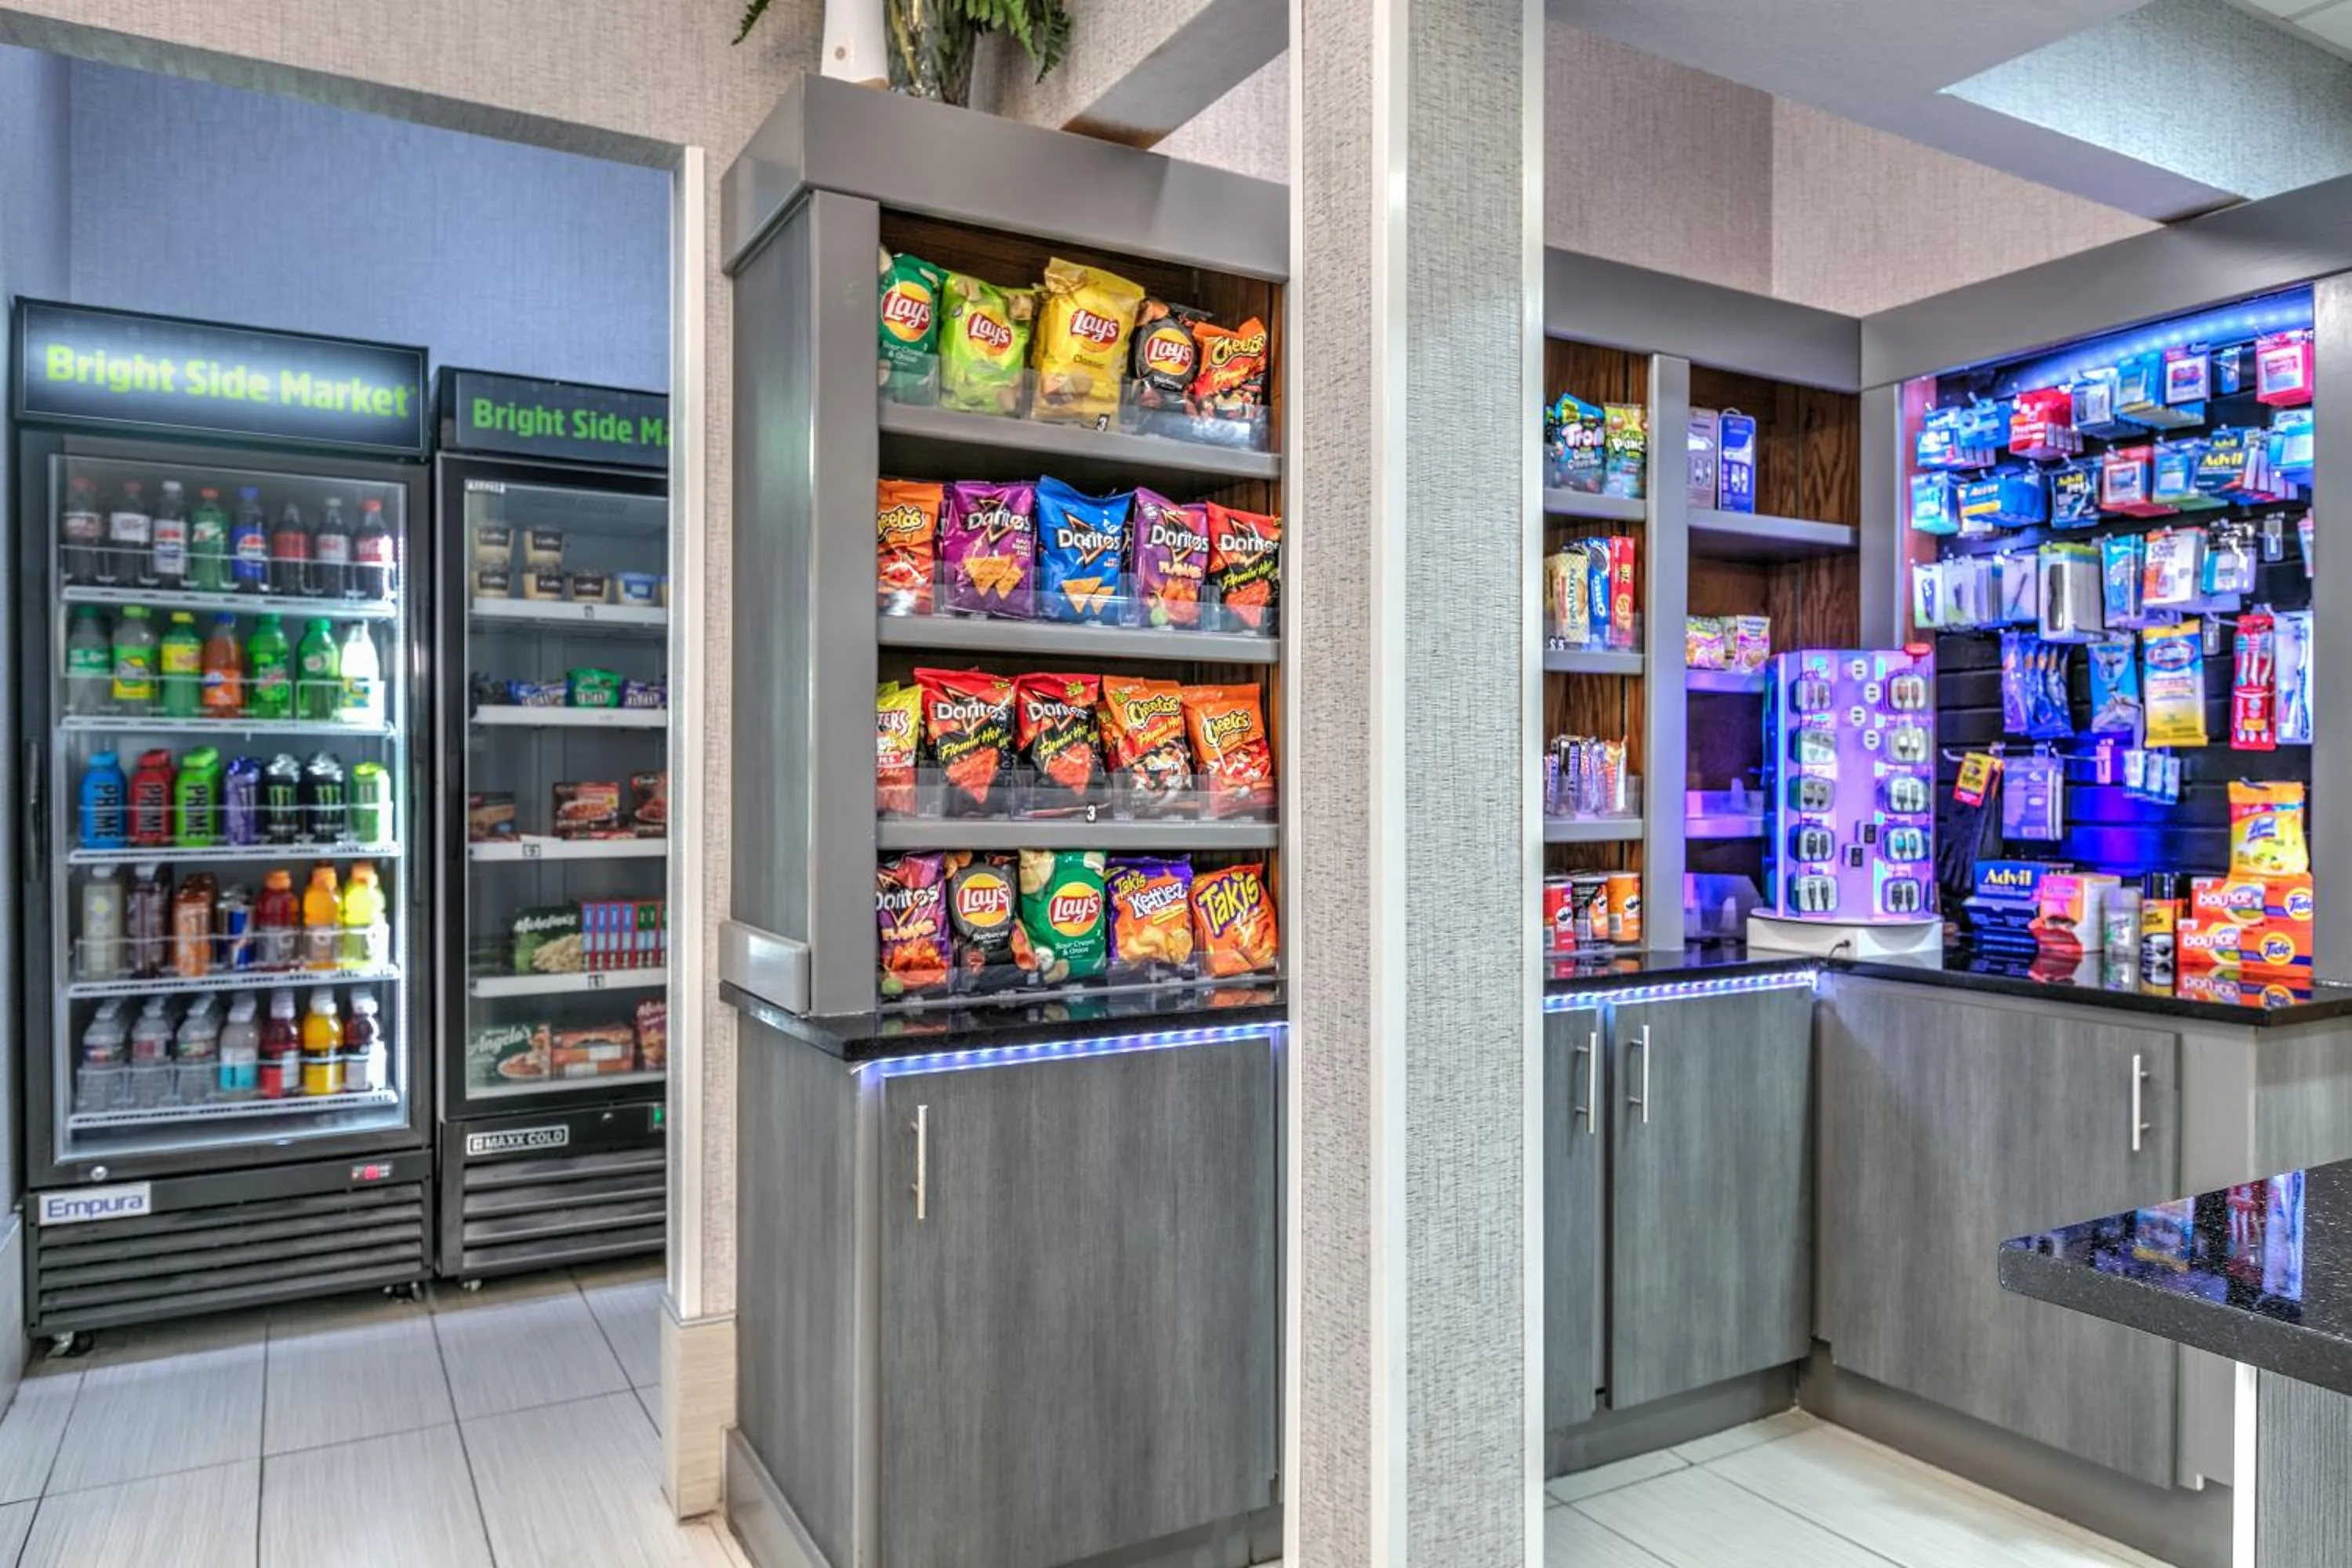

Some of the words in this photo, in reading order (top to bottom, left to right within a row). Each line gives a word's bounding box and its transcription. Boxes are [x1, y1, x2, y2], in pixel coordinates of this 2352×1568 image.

[884, 292, 931, 328] Lay's
[969, 313, 1011, 345] Lay's
[1072, 310, 1119, 343] Lay's
[1149, 337, 1192, 365] Lay's
[45, 343, 176, 393] Bright
[183, 359, 270, 402] Side
[279, 369, 411, 419] Market
[471, 397, 565, 437] Bright
[572, 408, 633, 445] Side
[1097, 416, 1109, 432] 3
[2202, 452, 2244, 466] Advil
[878, 506, 924, 535] eetos
[967, 507, 1031, 532] Doritos
[1056, 528, 1121, 550] Doritos
[1151, 524, 1209, 554] Doritos
[937, 702, 1007, 721] Doritos
[1126, 695, 1181, 728] Cheetos
[1203, 710, 1251, 746] Cheetos
[94, 783, 118, 838] PRIME
[186, 783, 209, 838] PRIME
[1086, 805, 1096, 822] 3
[1113, 870, 1146, 896] Takis
[1984, 868, 2032, 886] Advil
[962, 886, 1009, 913] Lay's
[1053, 894, 1100, 924] Lay's
[1127, 882, 1187, 919] Kettlez
[1198, 871, 1260, 936] Takis
[2183, 934, 2238, 948] bounce
[2264, 941, 2291, 956] Tide
[485, 1134, 525, 1149] MAXX
[528, 1130, 564, 1146] COLD
[46, 1193, 143, 1220] Empura
